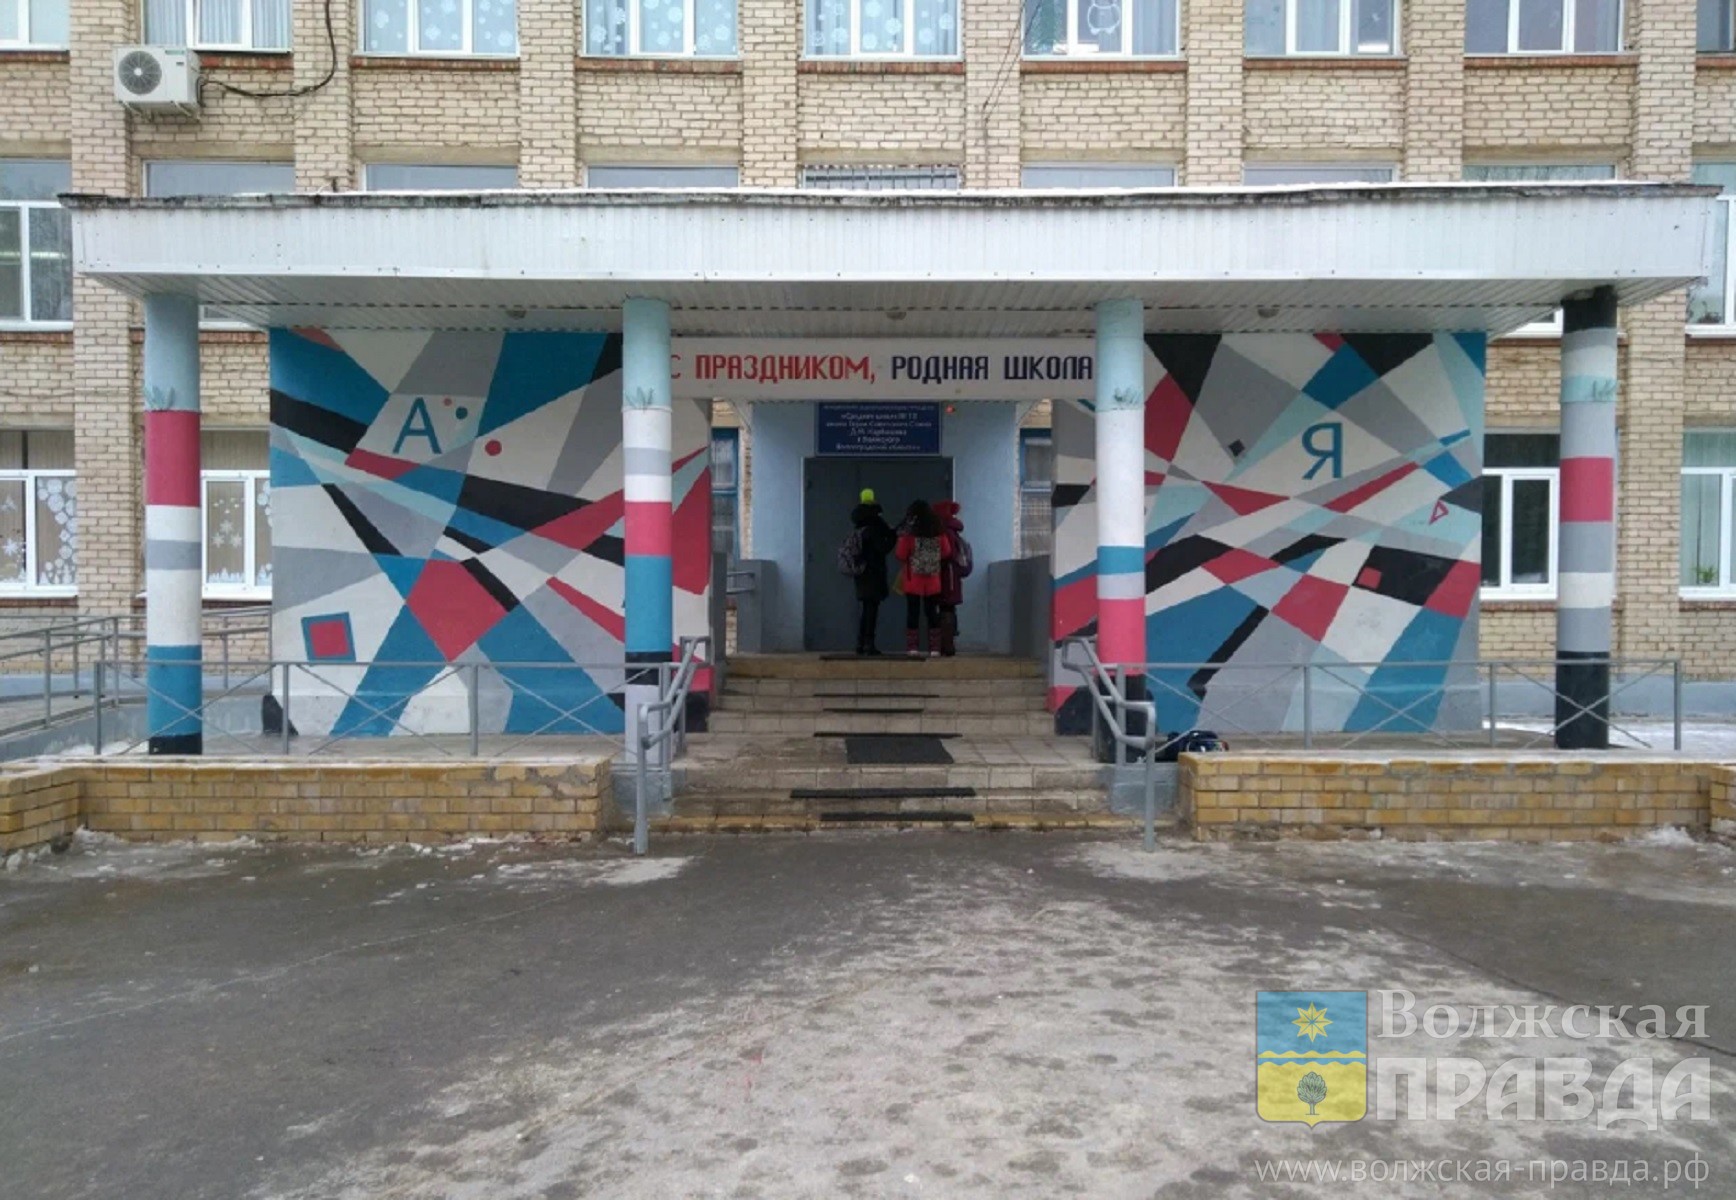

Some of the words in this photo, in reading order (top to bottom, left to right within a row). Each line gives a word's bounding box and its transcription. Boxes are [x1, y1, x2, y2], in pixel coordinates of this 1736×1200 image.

[695, 353, 876, 385] ПРАЗДНИКОМ,
[891, 355, 989, 385] РОДНАЯ
[1004, 355, 1093, 380] ШКОЛА
[392, 396, 442, 454] А
[1301, 421, 1343, 480] Я
